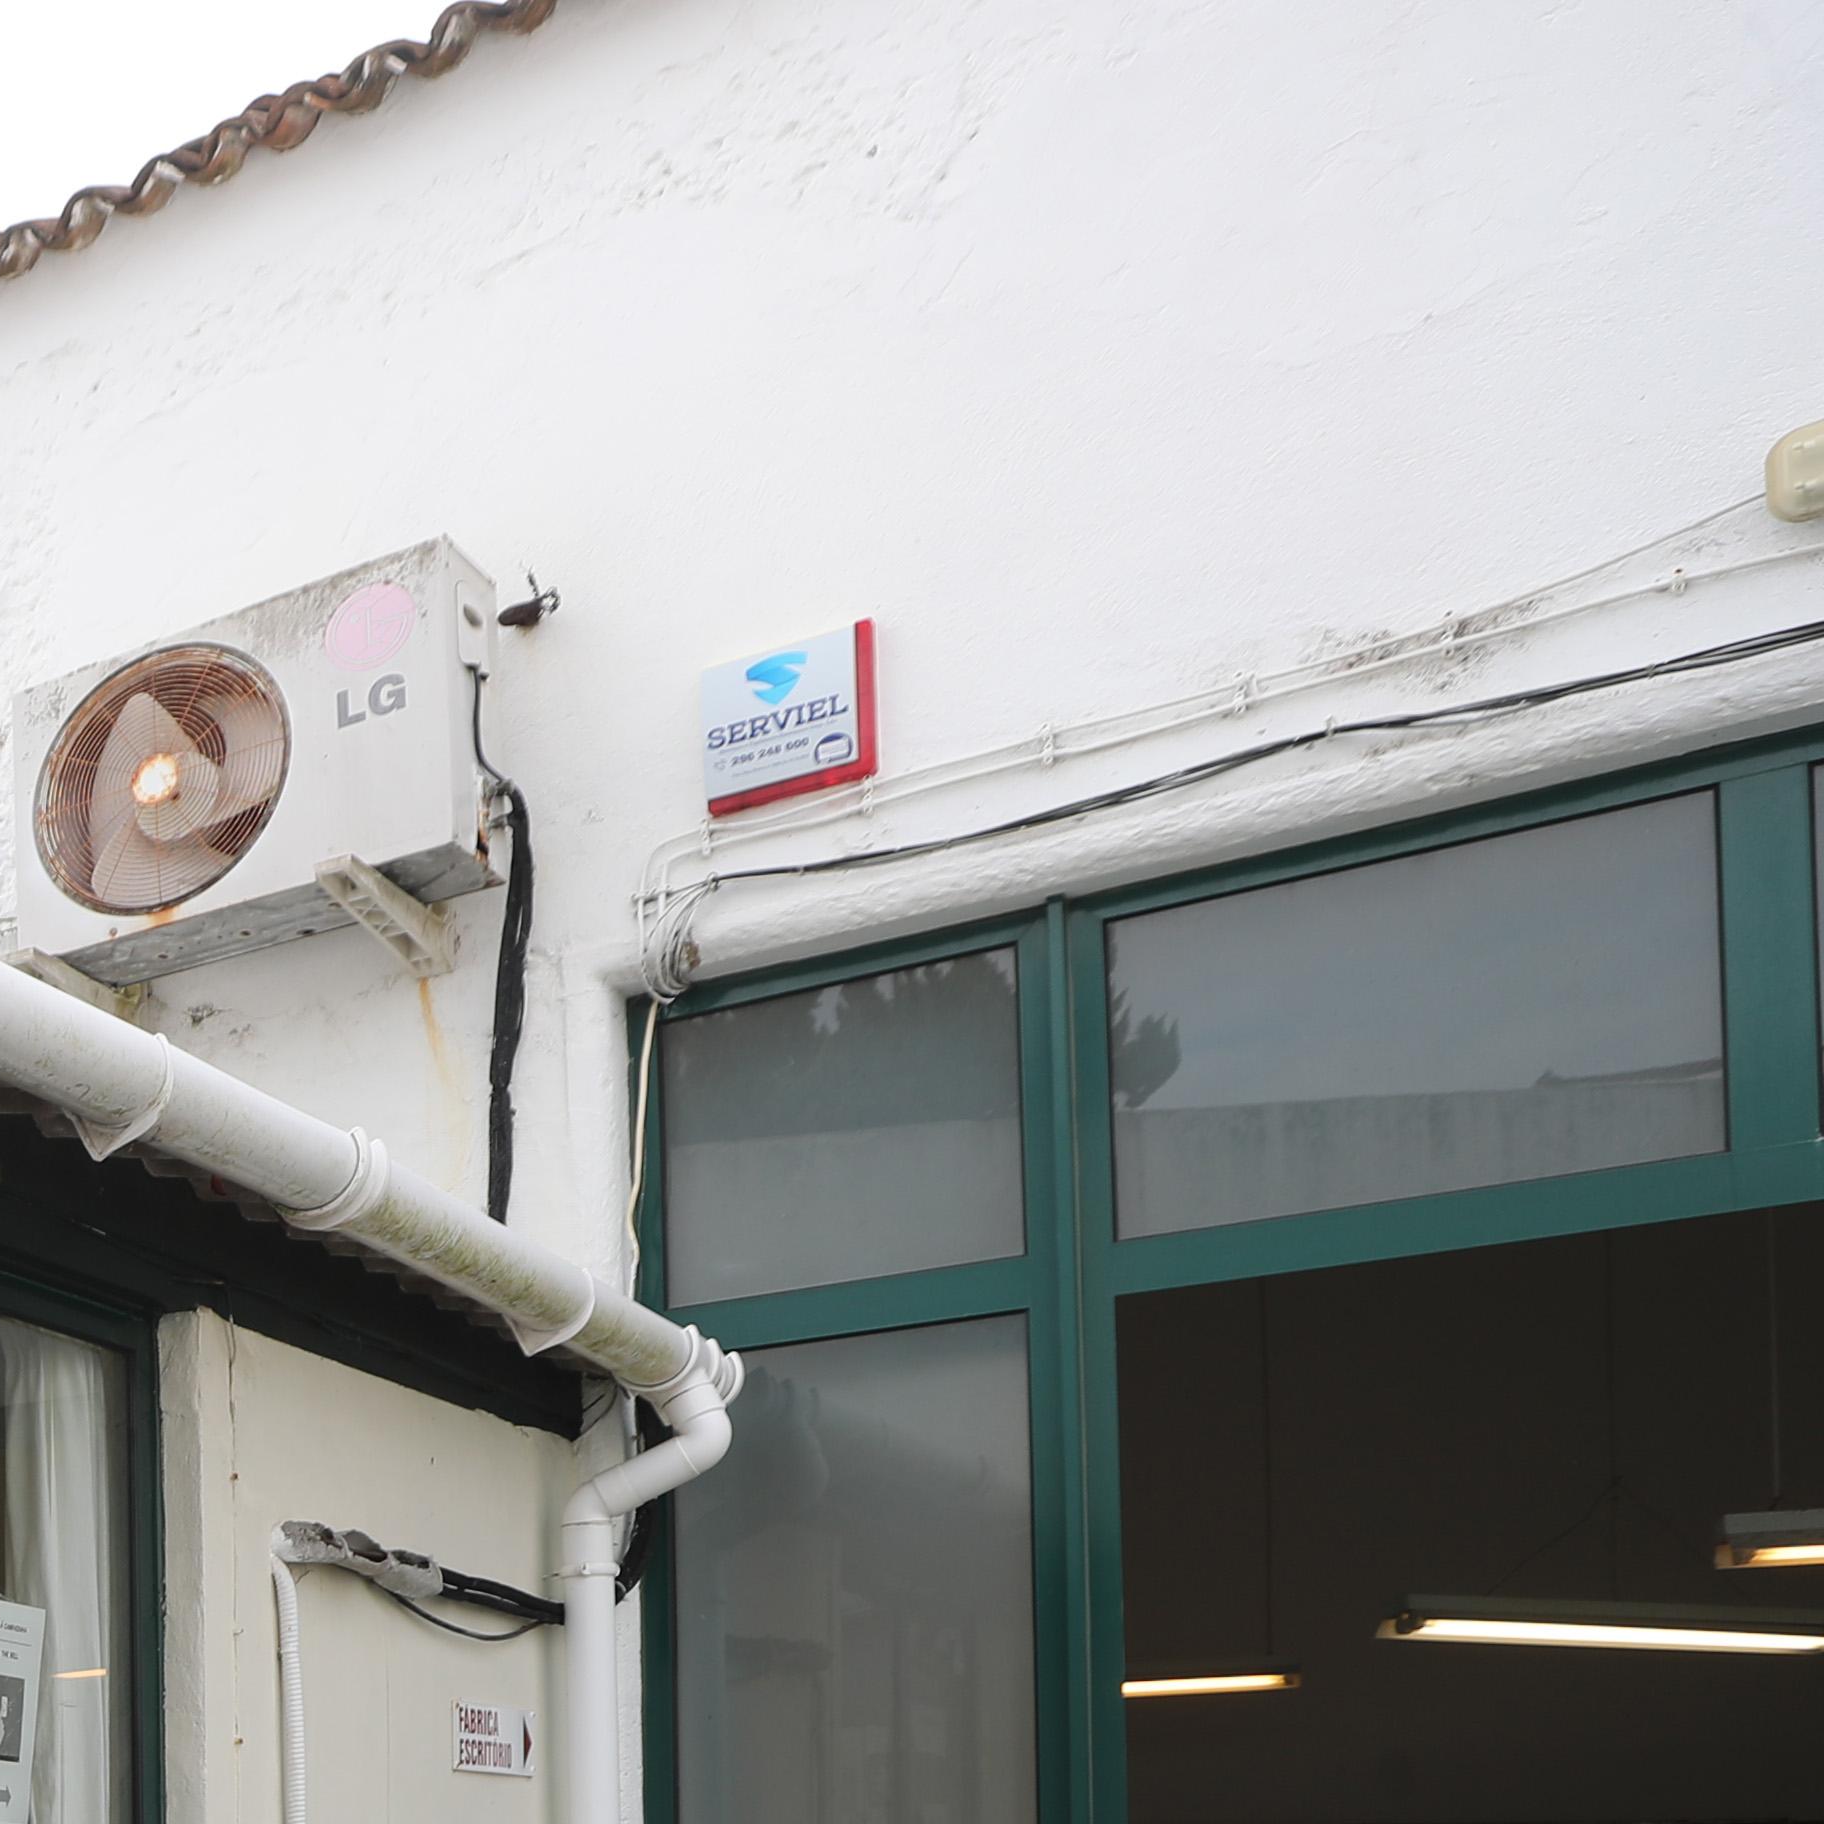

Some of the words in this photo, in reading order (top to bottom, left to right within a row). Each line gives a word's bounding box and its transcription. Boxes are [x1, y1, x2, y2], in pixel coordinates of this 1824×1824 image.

[336, 672, 407, 729] LG
[707, 693, 850, 750] SERVIEL
[459, 1703, 500, 1737] FÁBRICA
[459, 1738, 512, 1769] ESCRITÓRIO
